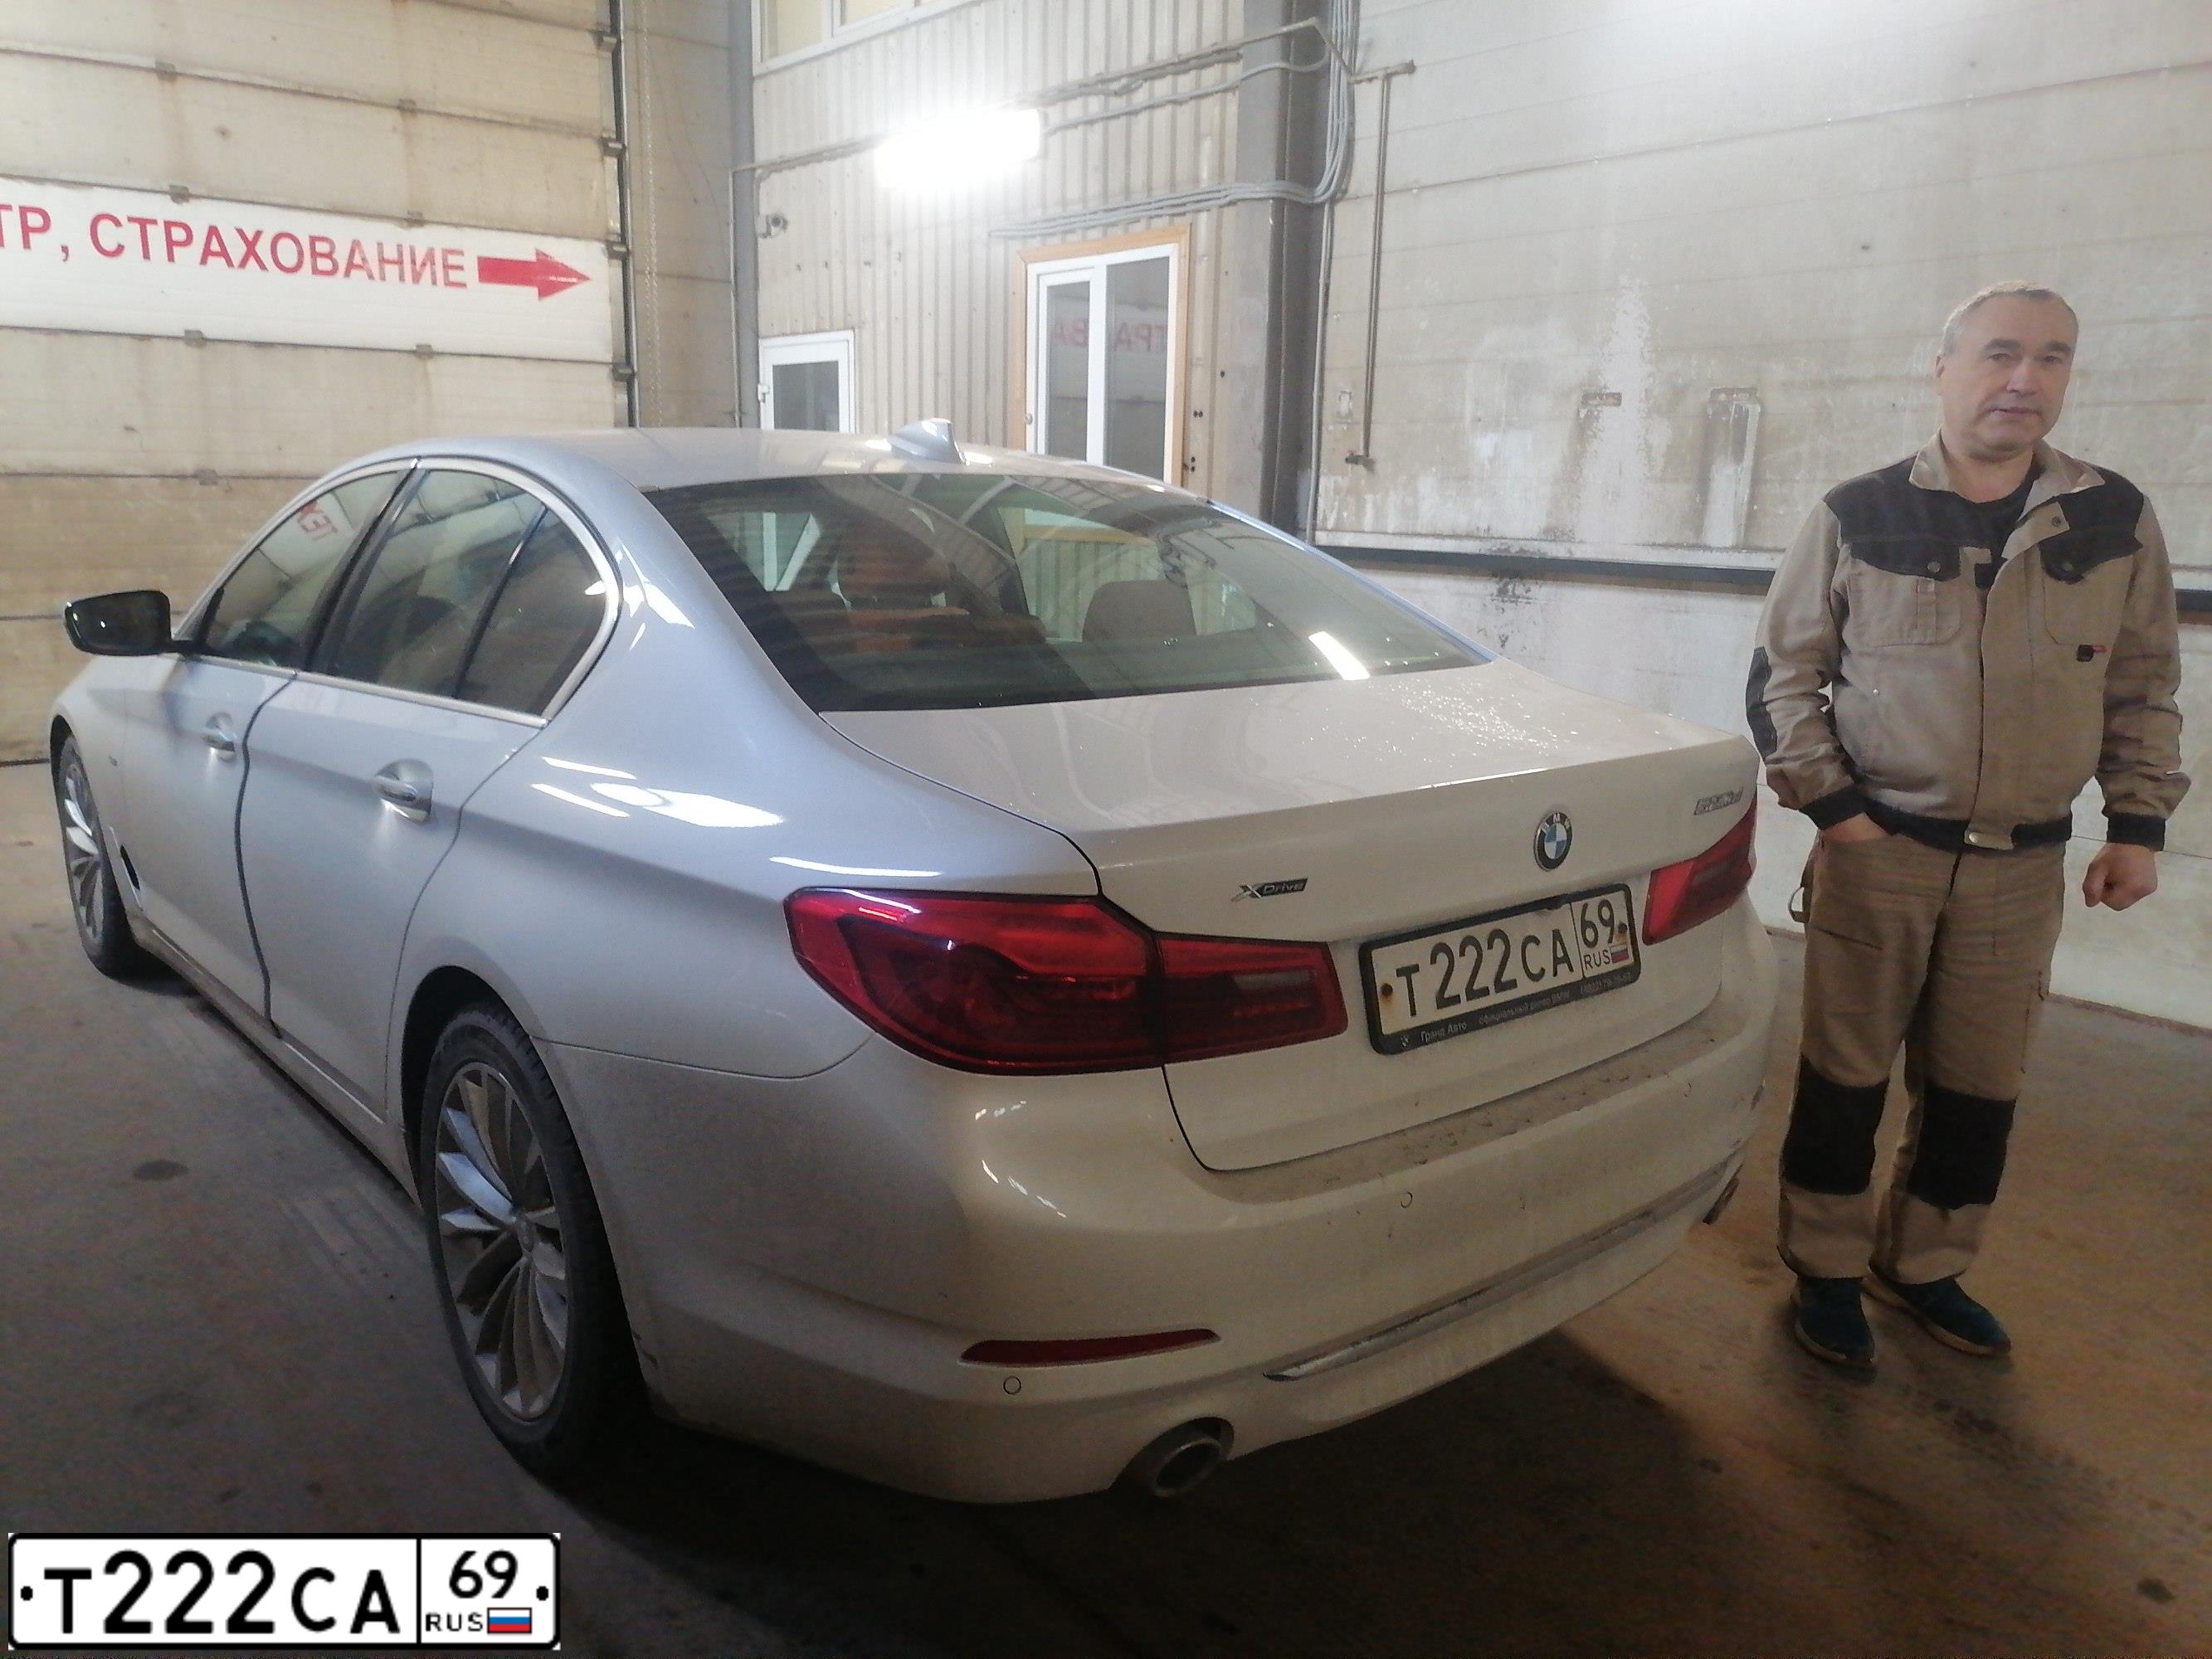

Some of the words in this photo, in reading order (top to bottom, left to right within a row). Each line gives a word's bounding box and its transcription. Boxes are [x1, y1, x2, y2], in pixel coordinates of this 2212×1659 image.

[90, 212, 468, 288] СТРАХОВАНИЕ
[1538, 812, 1571, 833] BMW
[1580, 899, 1615, 947] 69
[1584, 951, 1610, 971] RUS
